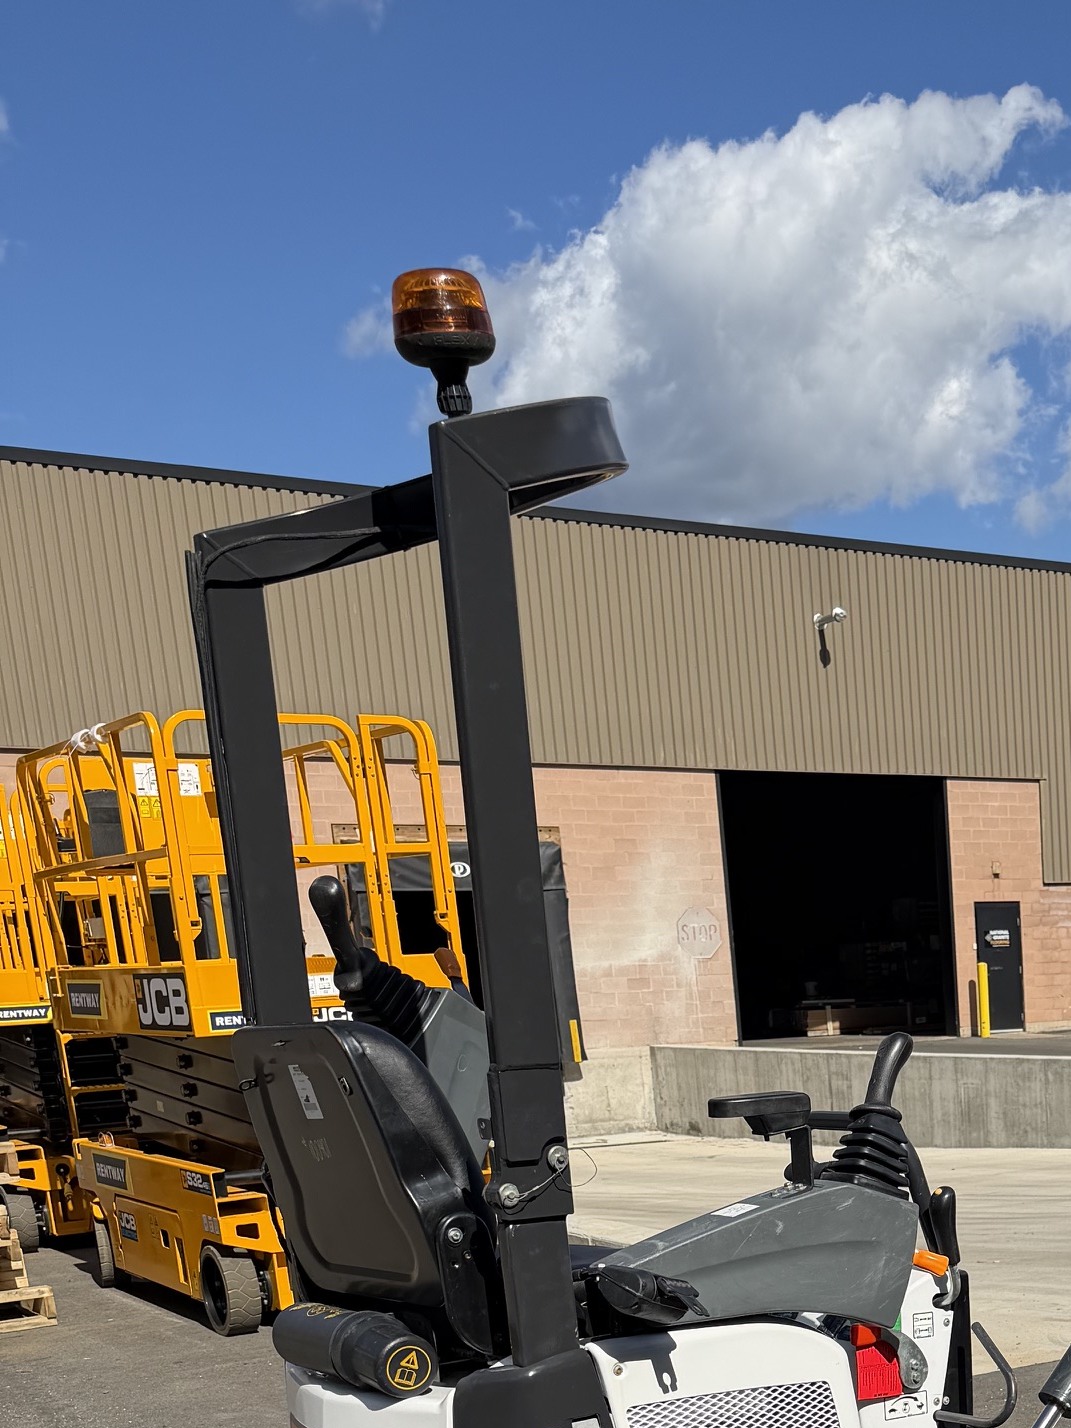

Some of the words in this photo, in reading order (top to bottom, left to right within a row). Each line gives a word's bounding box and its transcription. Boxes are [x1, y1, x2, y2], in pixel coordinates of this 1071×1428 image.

[681, 924, 718, 941] STOP
[70, 992, 100, 1009] RENTWAY
[138, 977, 190, 1026] JCB
[96, 1162, 125, 1182] RENTWAY
[120, 1211, 137, 1231] JCB
